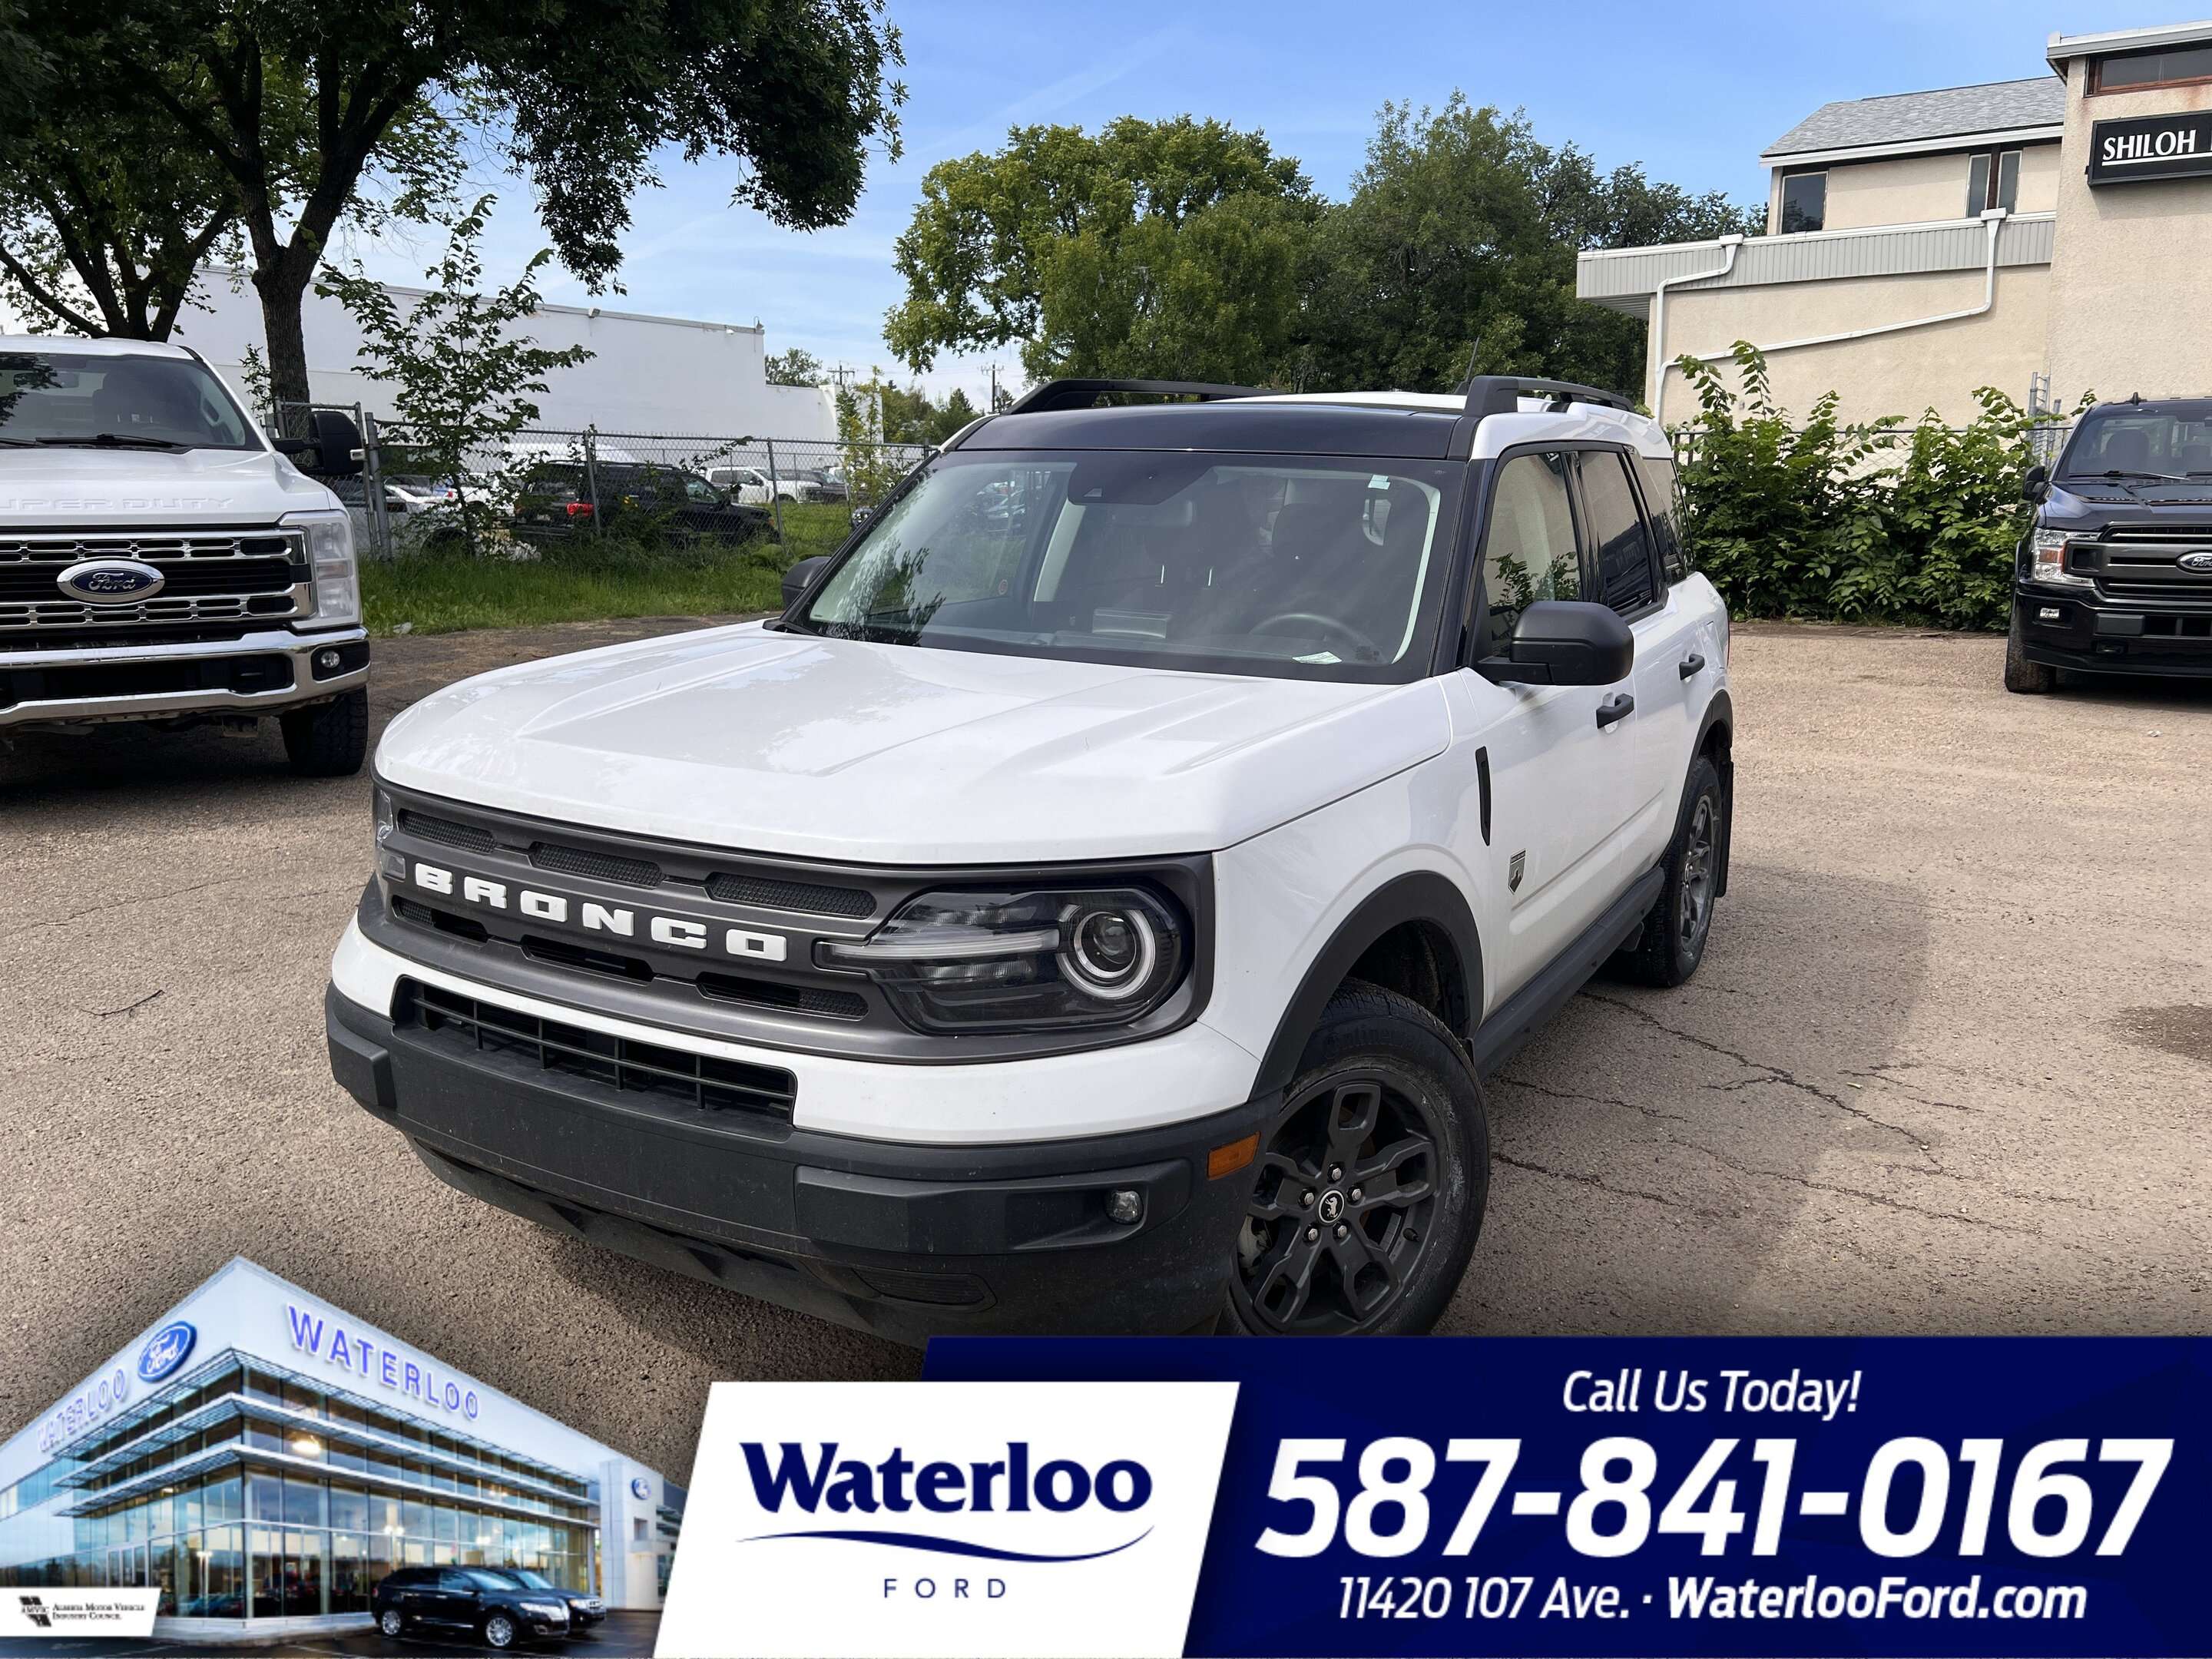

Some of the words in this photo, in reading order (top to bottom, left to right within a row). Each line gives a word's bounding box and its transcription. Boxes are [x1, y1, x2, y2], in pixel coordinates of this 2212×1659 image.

[2103, 129, 2197, 161] SHILOH
[0, 498, 114, 511] UPER
[122, 498, 233, 510] DUTY
[2191, 556, 2212, 567] For
[88, 571, 137, 591] Ford
[415, 862, 787, 962] BRONCO
